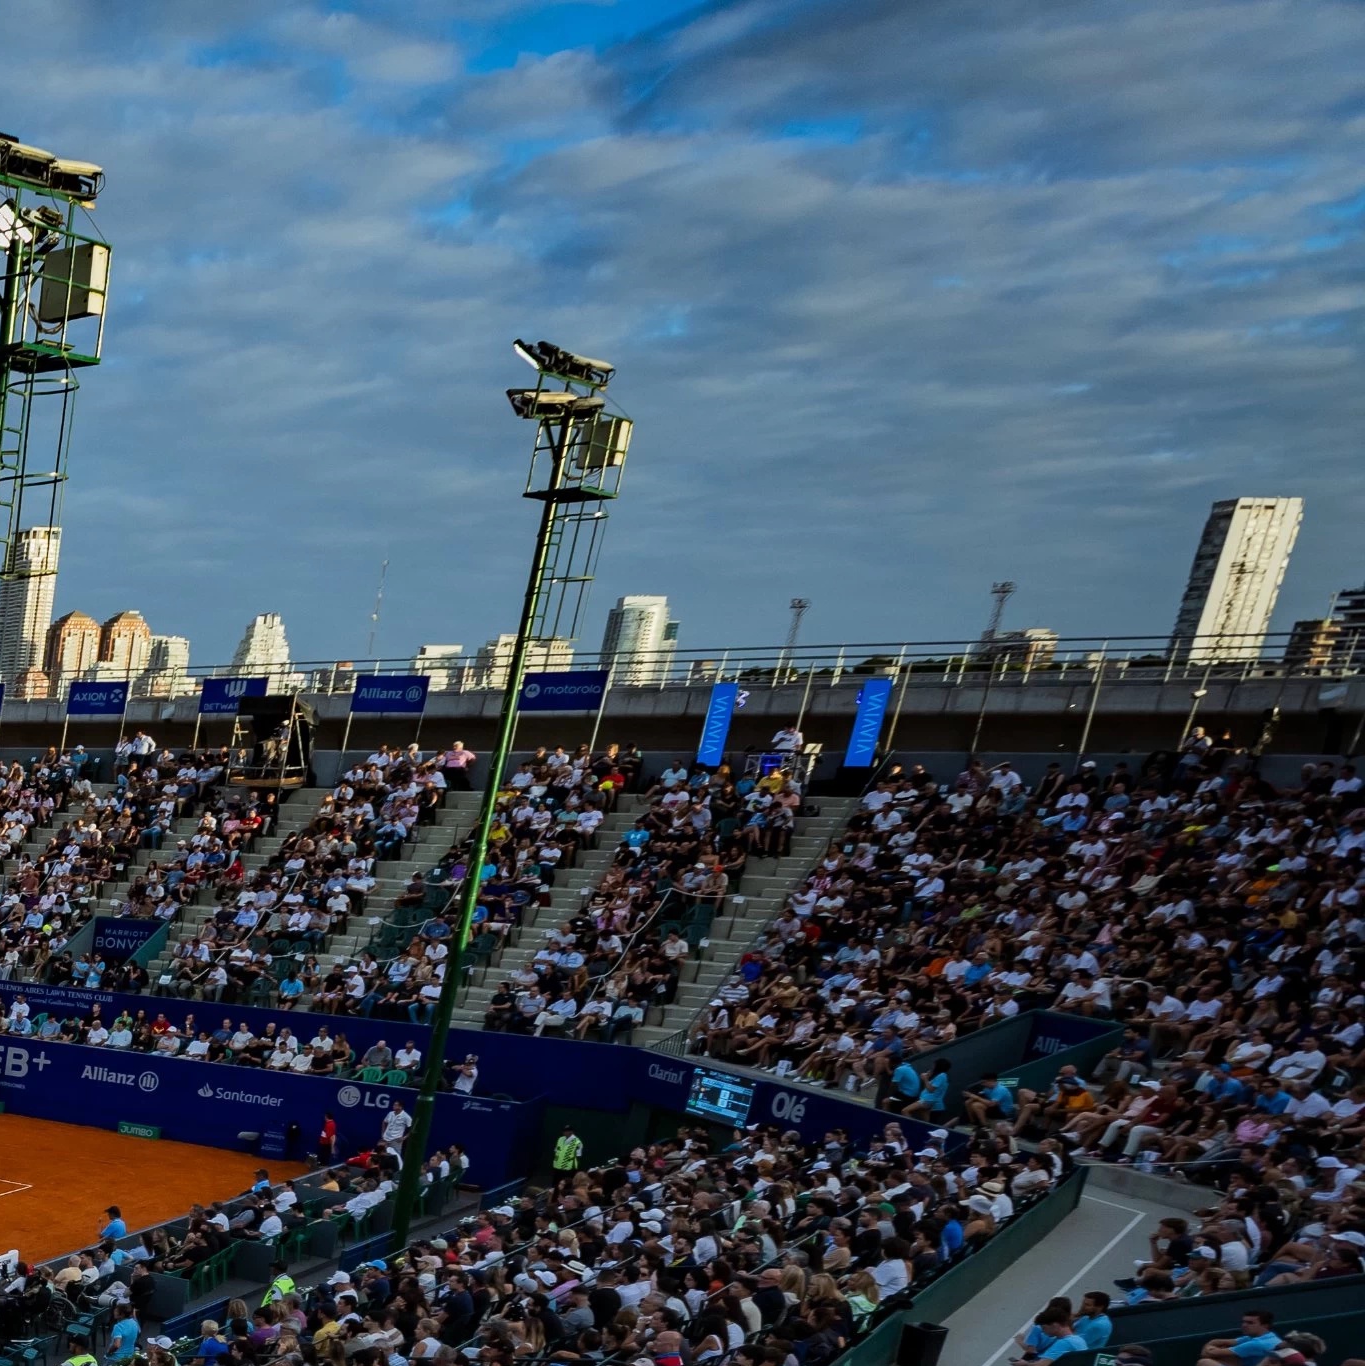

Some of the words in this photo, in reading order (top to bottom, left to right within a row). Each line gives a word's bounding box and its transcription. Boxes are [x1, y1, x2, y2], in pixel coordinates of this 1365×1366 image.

[73, 691, 108, 702] AXION
[358, 687, 403, 699] Allianz
[543, 684, 602, 695] motorola
[204, 702, 239, 711] BETWAR
[704, 696, 730, 754] VIAVIVA
[855, 692, 886, 754] VIAVIVA
[105, 928, 149, 937] MARRIOTT
[95, 937, 145, 950] BONVO
[24, 986, 45, 995] AIRES
[46, 988, 66, 996] LAWN
[68, 990, 93, 1000] TENNIS
[94, 994, 113, 1002] CLUB
[81, 1065, 136, 1086] Allianz
[215, 1087, 284, 1107] Santander
[363, 1090, 391, 1109] LG
[771, 1091, 808, 1123] Olé
[120, 1125, 154, 1137] JUMBO
